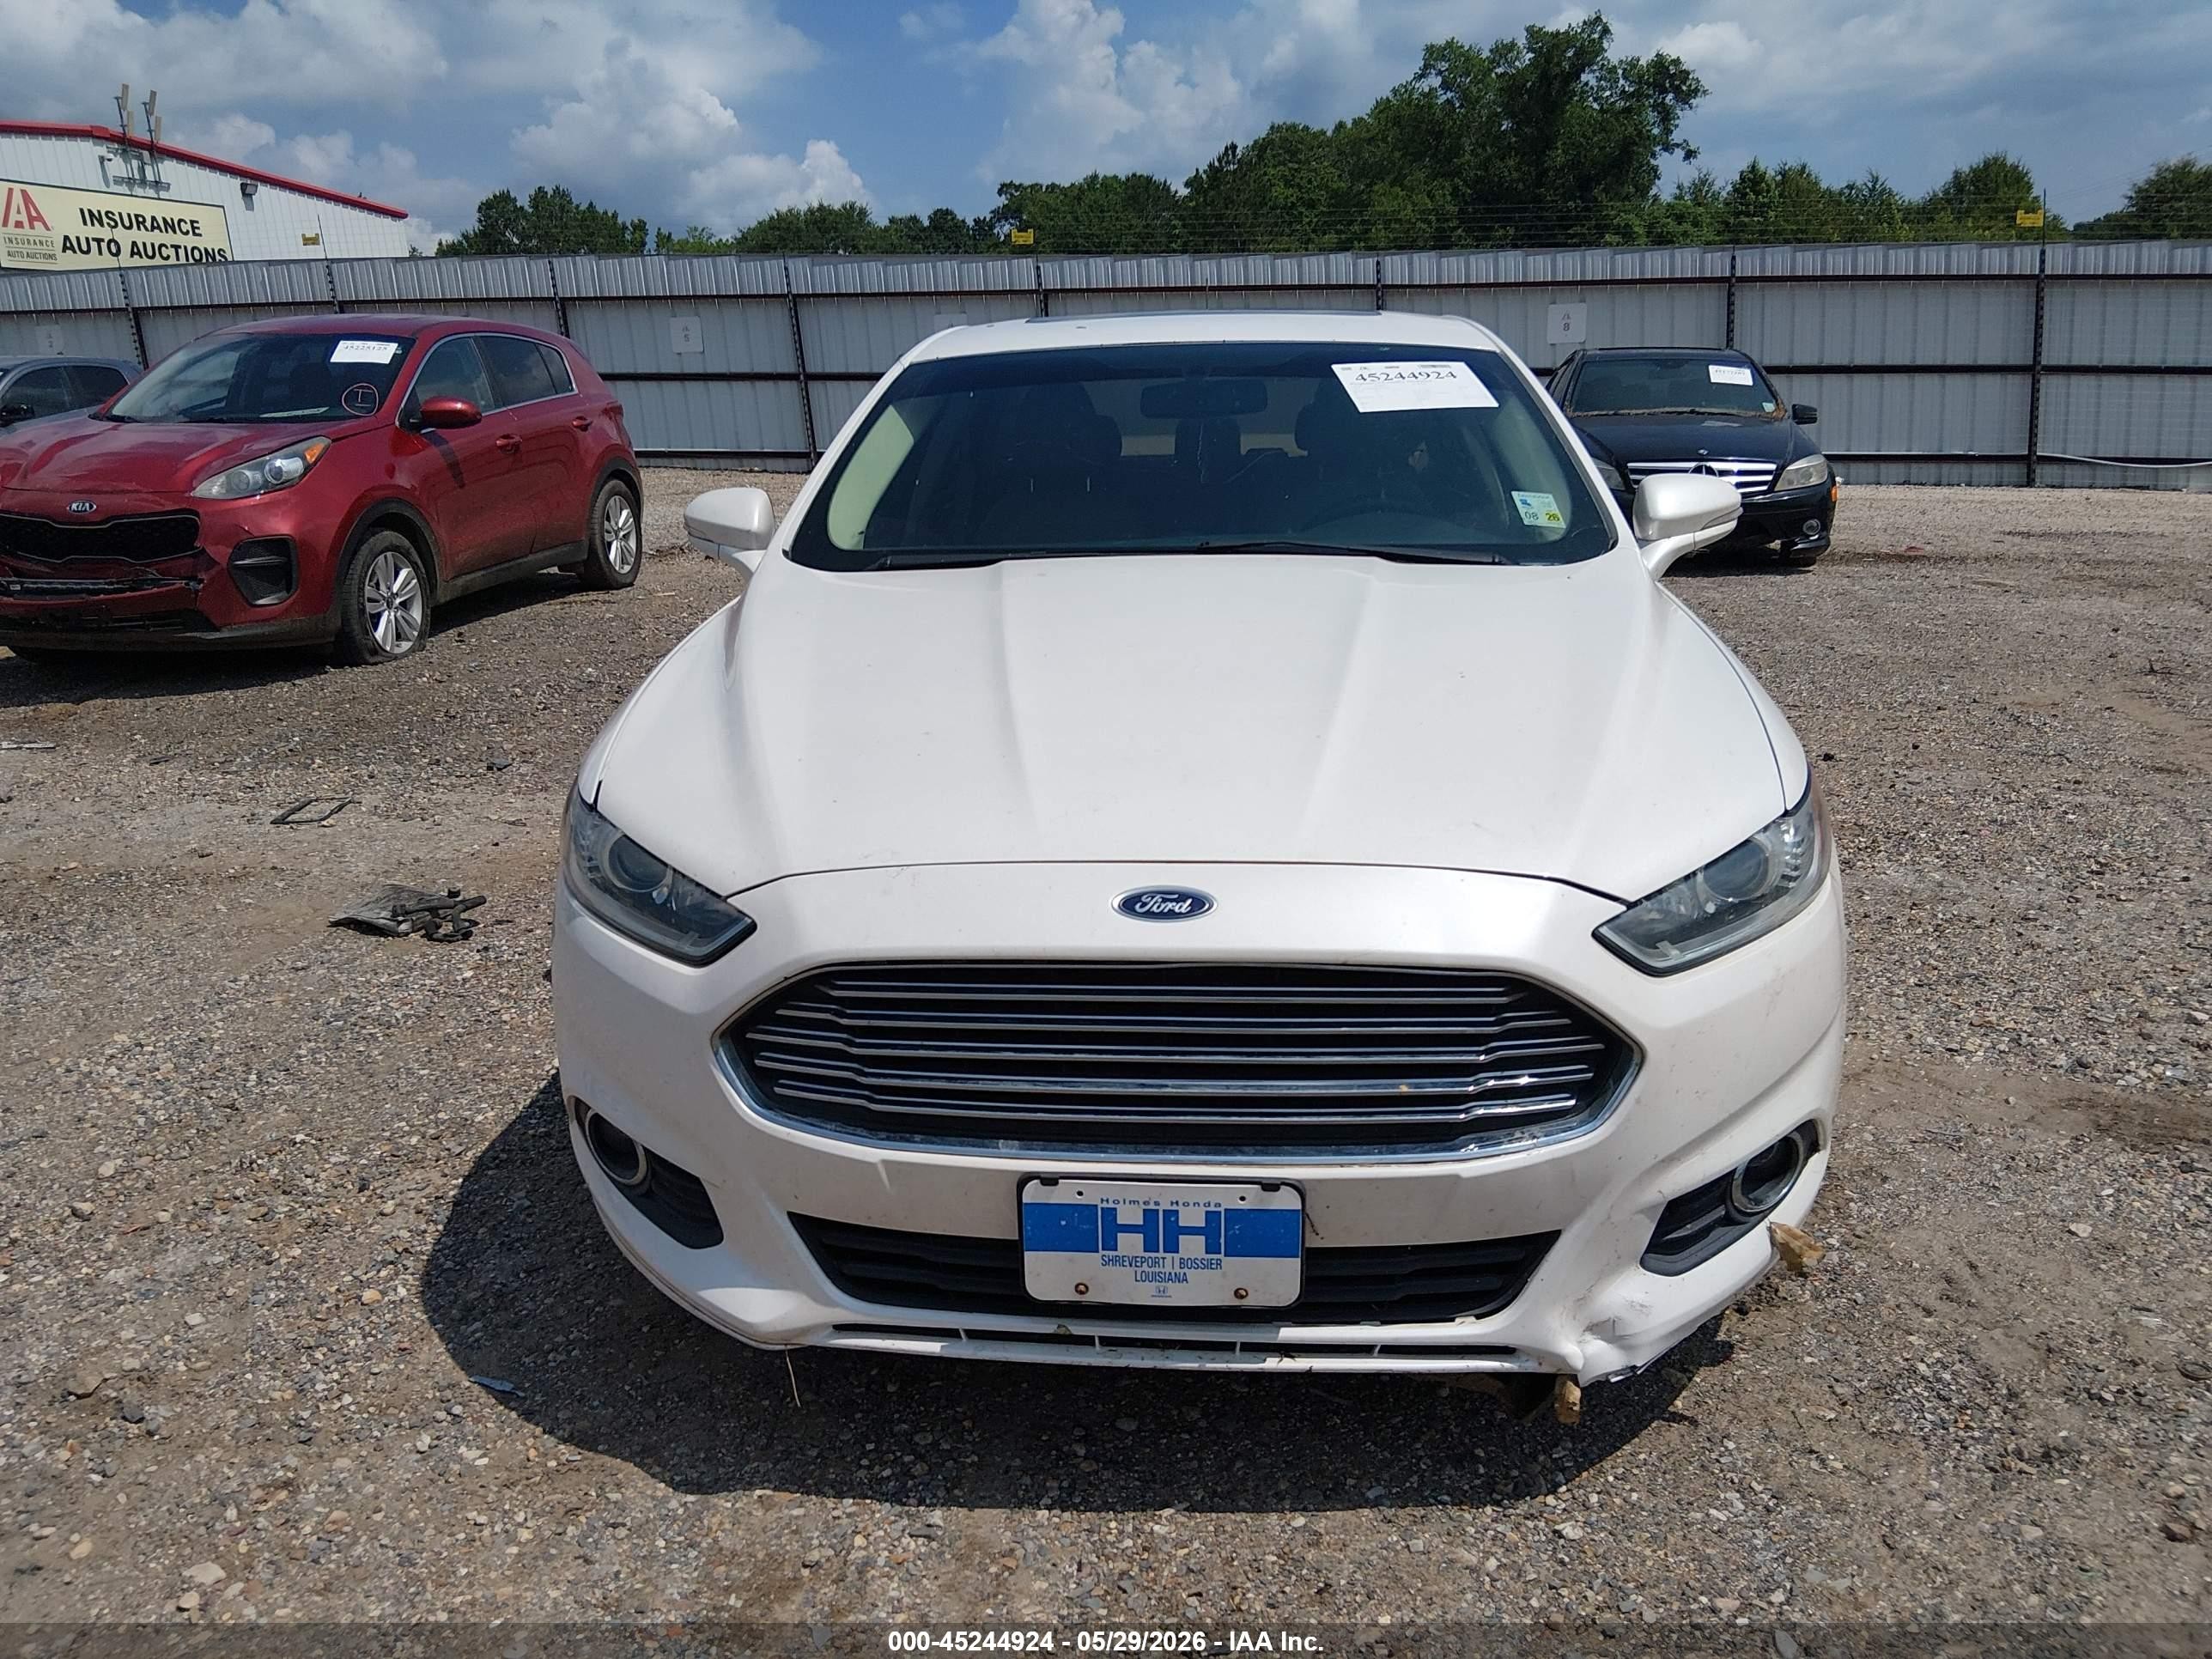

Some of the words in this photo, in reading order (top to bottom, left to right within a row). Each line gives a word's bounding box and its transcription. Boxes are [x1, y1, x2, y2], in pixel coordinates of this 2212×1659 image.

[79, 207, 203, 237] INSURANCE
[3, 236, 55, 247] INSURANCE
[62, 234, 122, 258] AUTO
[130, 240, 228, 264] AUCTIONS
[7, 250, 25, 258] AUTO
[27, 251, 58, 261] AUCTIONS
[1355, 371, 1457, 382] 45244924
[71, 502, 90, 511] KIA
[1524, 511, 1539, 521] 08
[1546, 512, 1560, 522] 26
[1134, 893, 1193, 914] Ford
[1100, 1197, 1161, 1206] Holmes
[1170, 1200, 1222, 1208] Honda
[1101, 1207, 1221, 1255] HH
[1101, 1254, 1167, 1268] SHREVEPORT
[1179, 1257, 1222, 1270] BOSSIER
[1134, 1271, 1188, 1284] LOUISIANA
